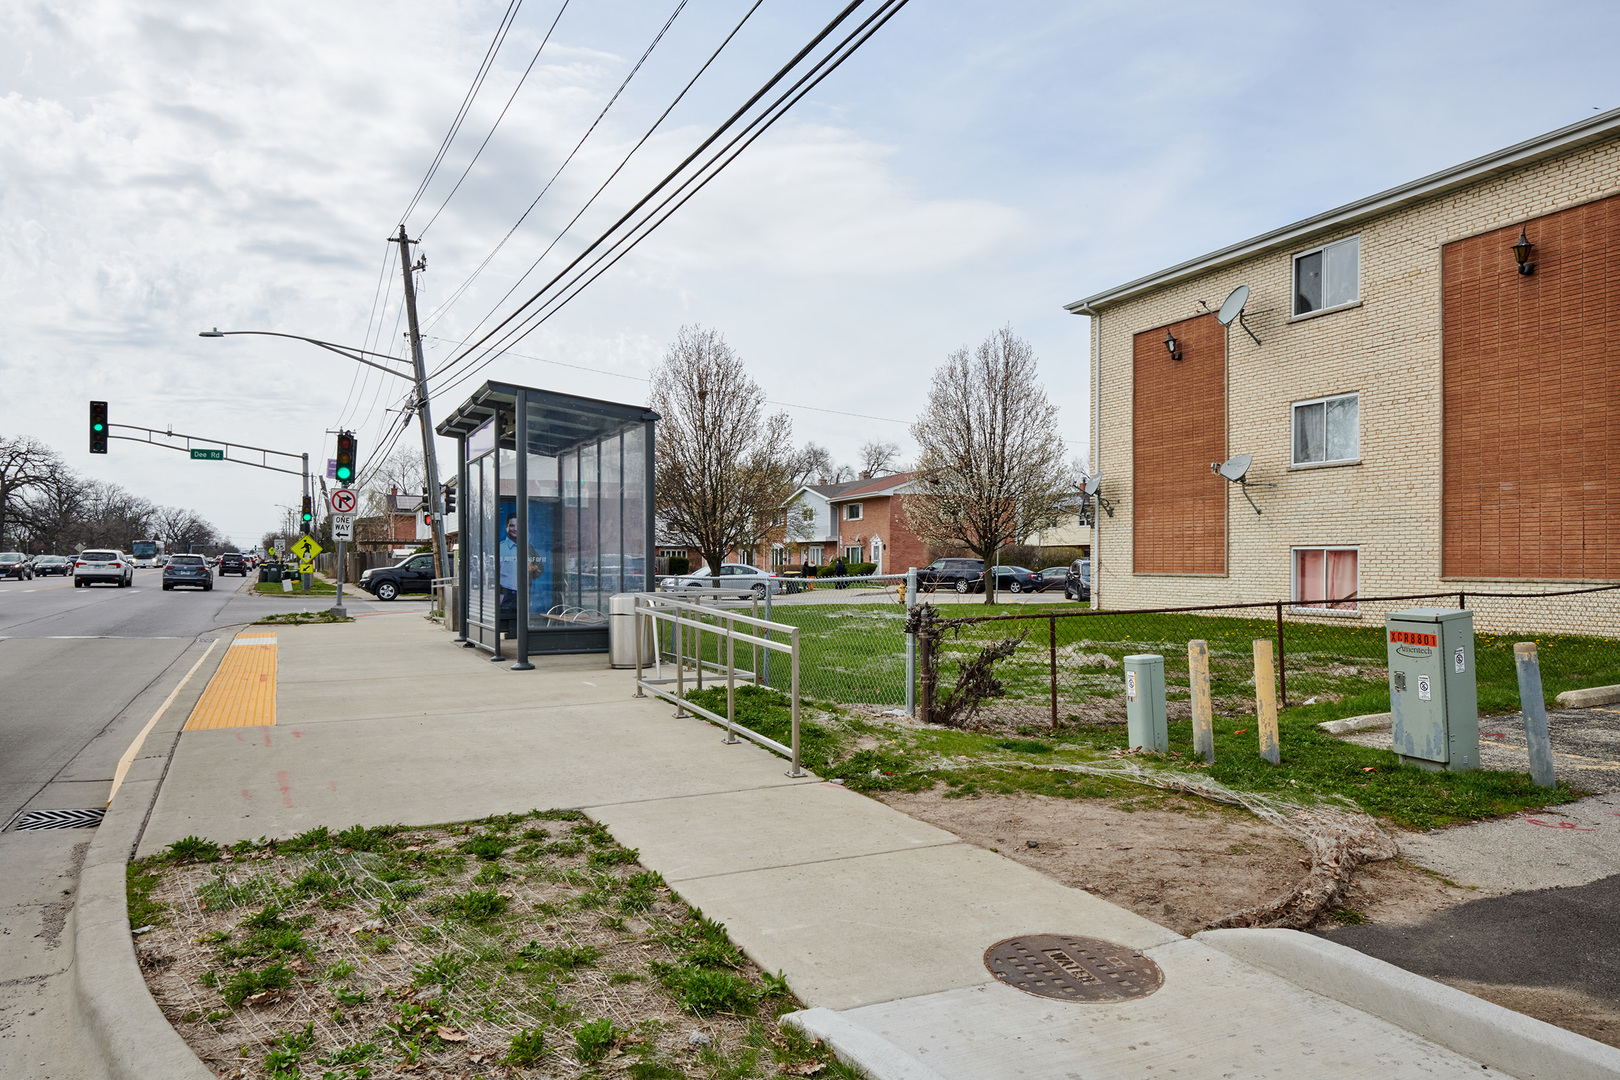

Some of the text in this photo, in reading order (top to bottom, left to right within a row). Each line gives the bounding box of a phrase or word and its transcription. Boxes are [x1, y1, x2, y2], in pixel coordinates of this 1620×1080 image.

[336, 516, 350, 524] ONE
[1391, 632, 1435, 646] XCR8801
[1399, 644, 1432, 655] Ameritech
[1050, 952, 1096, 983] WATER
